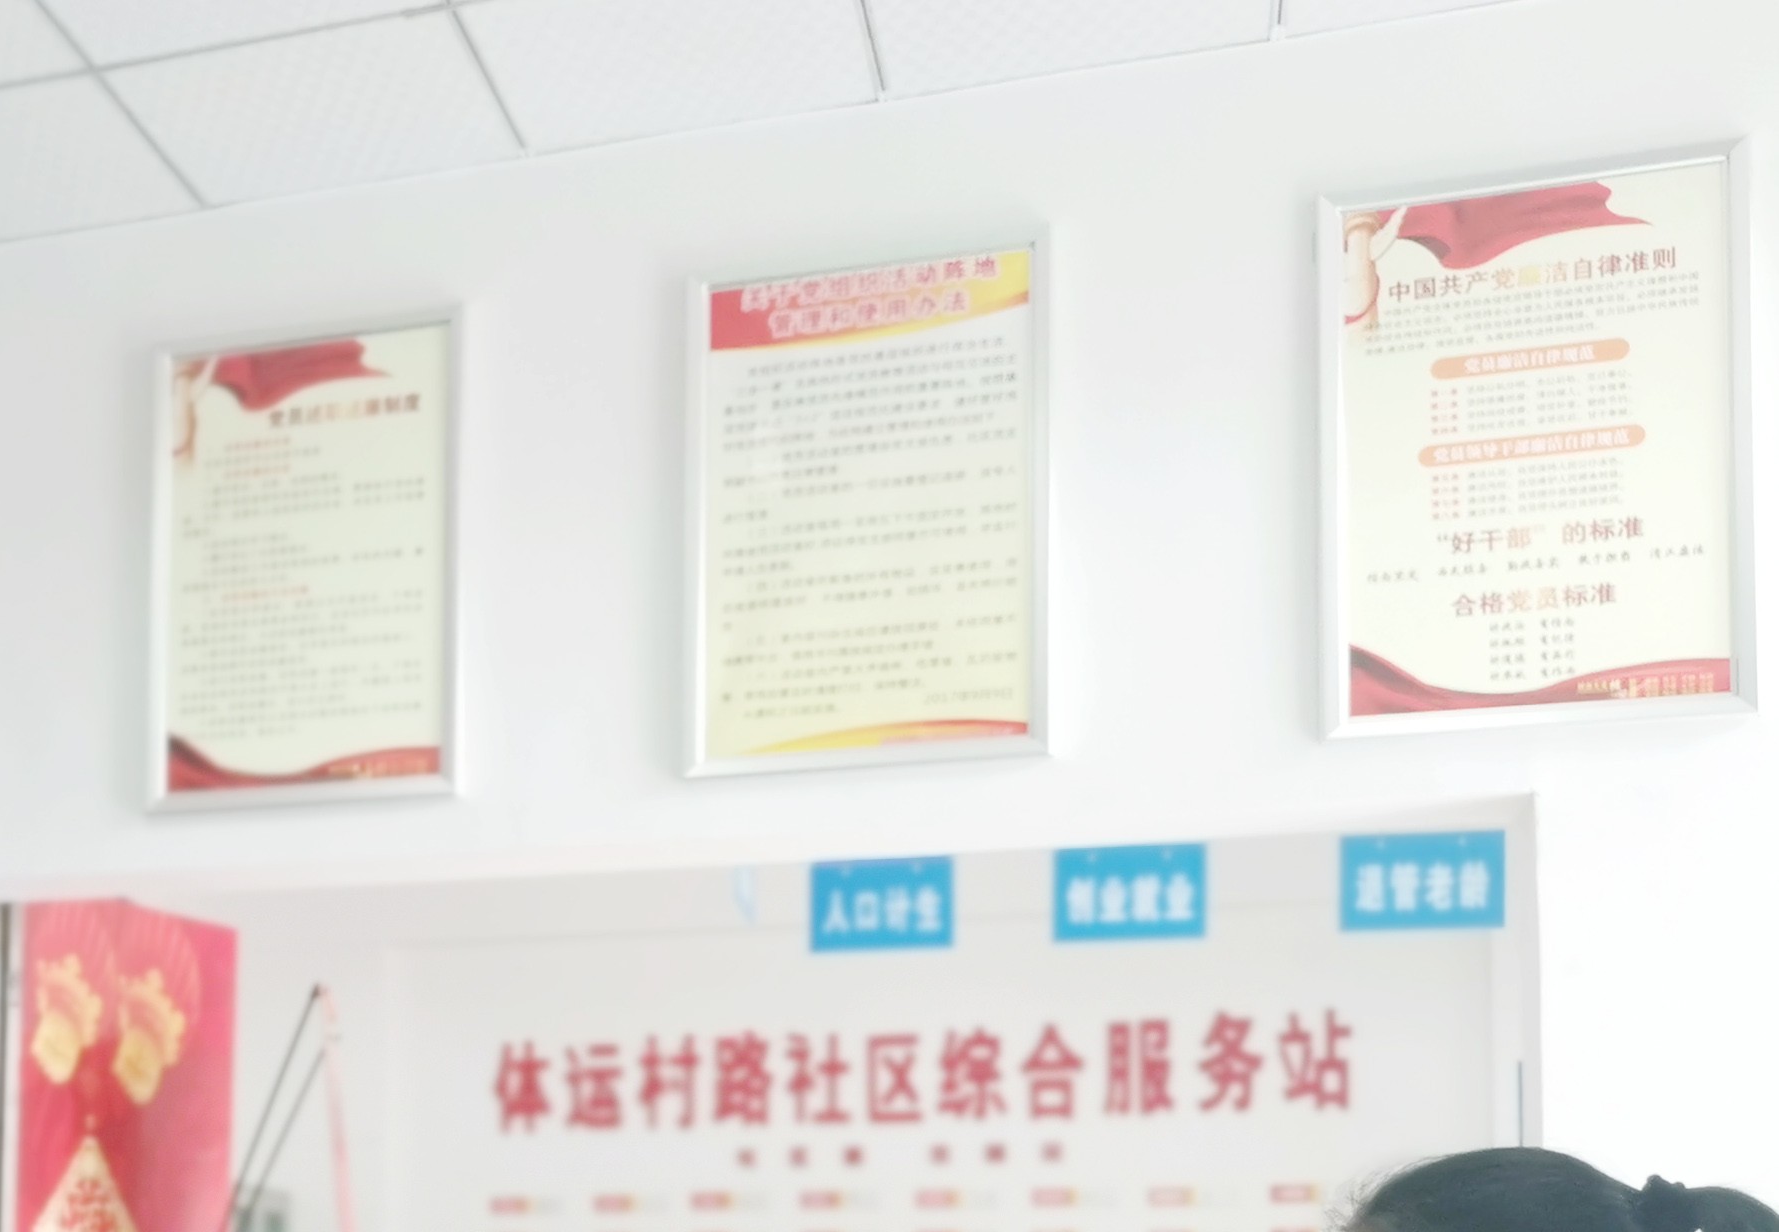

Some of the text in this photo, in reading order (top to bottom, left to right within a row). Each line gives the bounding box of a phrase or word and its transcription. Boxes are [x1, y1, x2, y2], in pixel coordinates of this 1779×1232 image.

[1453, 582, 1618, 618] 合格党员标准
[492, 1008, 1354, 1132] 体运村路社区综合服务站
